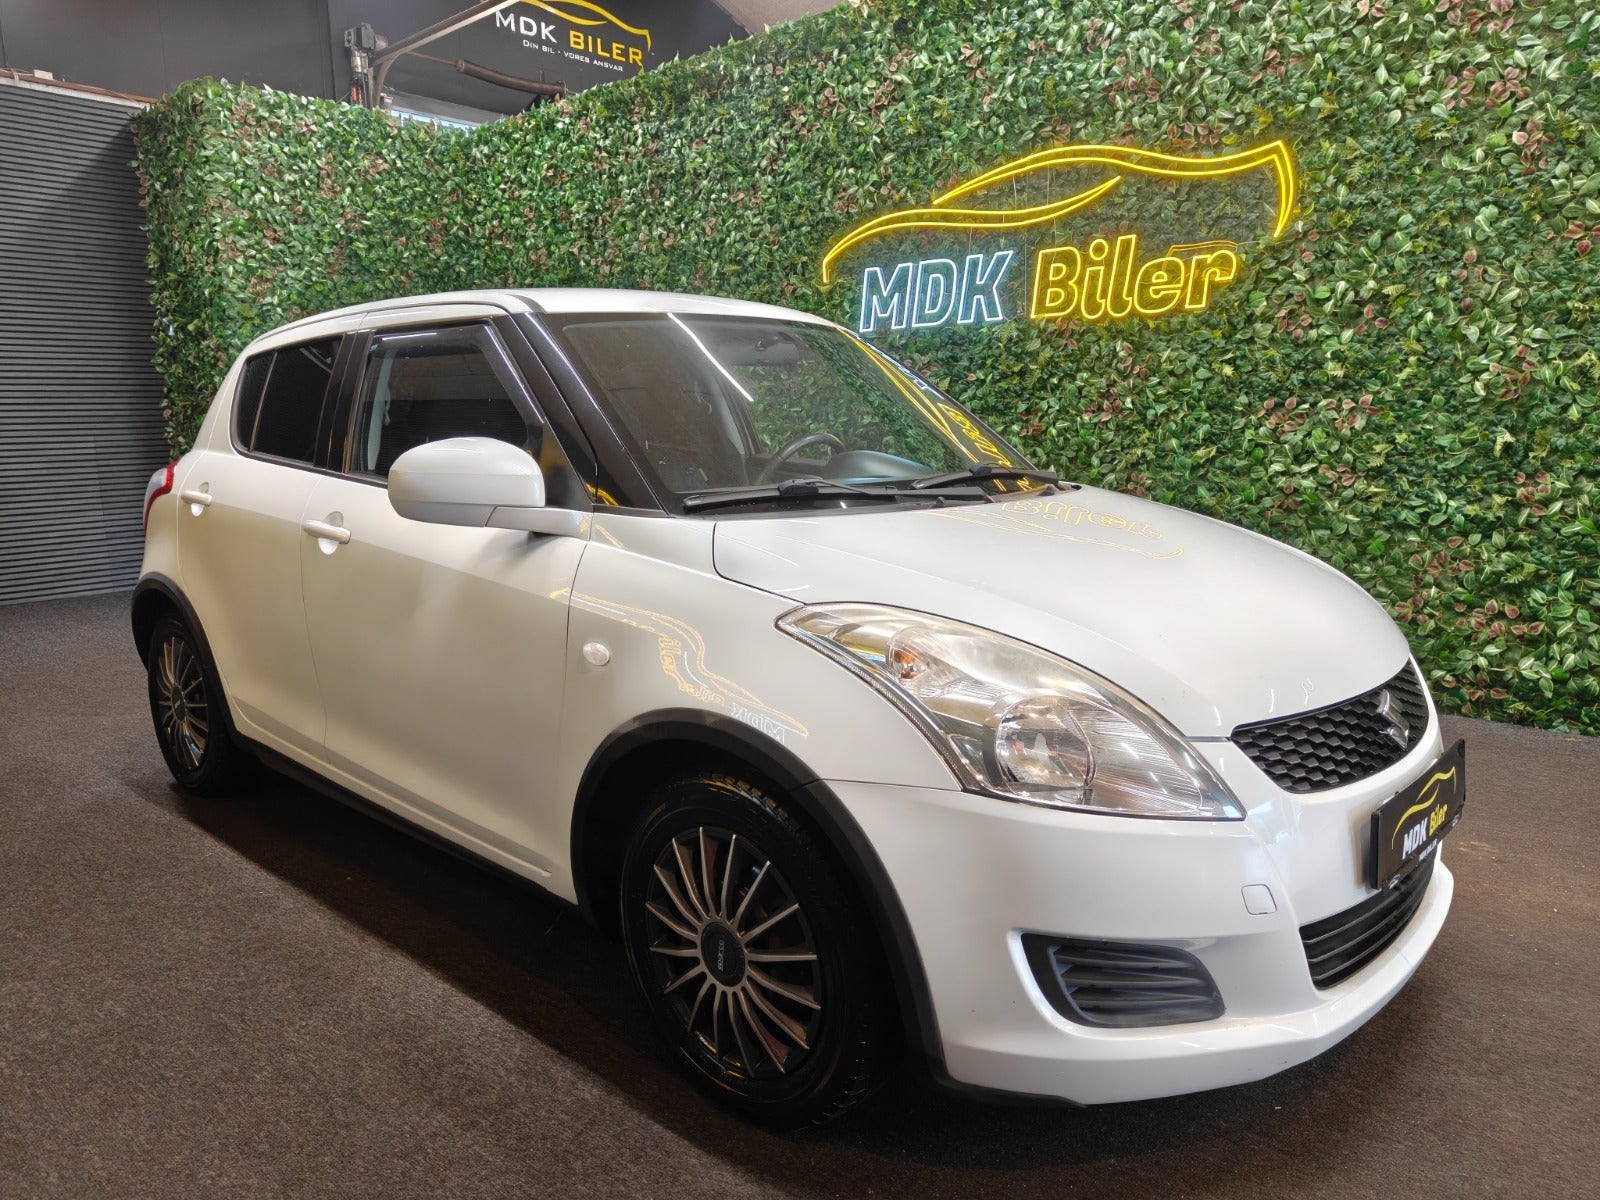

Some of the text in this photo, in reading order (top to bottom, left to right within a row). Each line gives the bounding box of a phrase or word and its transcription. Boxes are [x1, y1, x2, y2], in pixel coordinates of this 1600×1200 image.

[496, 10, 643, 66] MDK BILER
[523, 40, 624, 73] DIN BIL VORES ANSVAR
[859, 234, 1238, 333] MDK Biler
[1402, 817, 1428, 860] MDK
[1429, 804, 1448, 837] Biler
